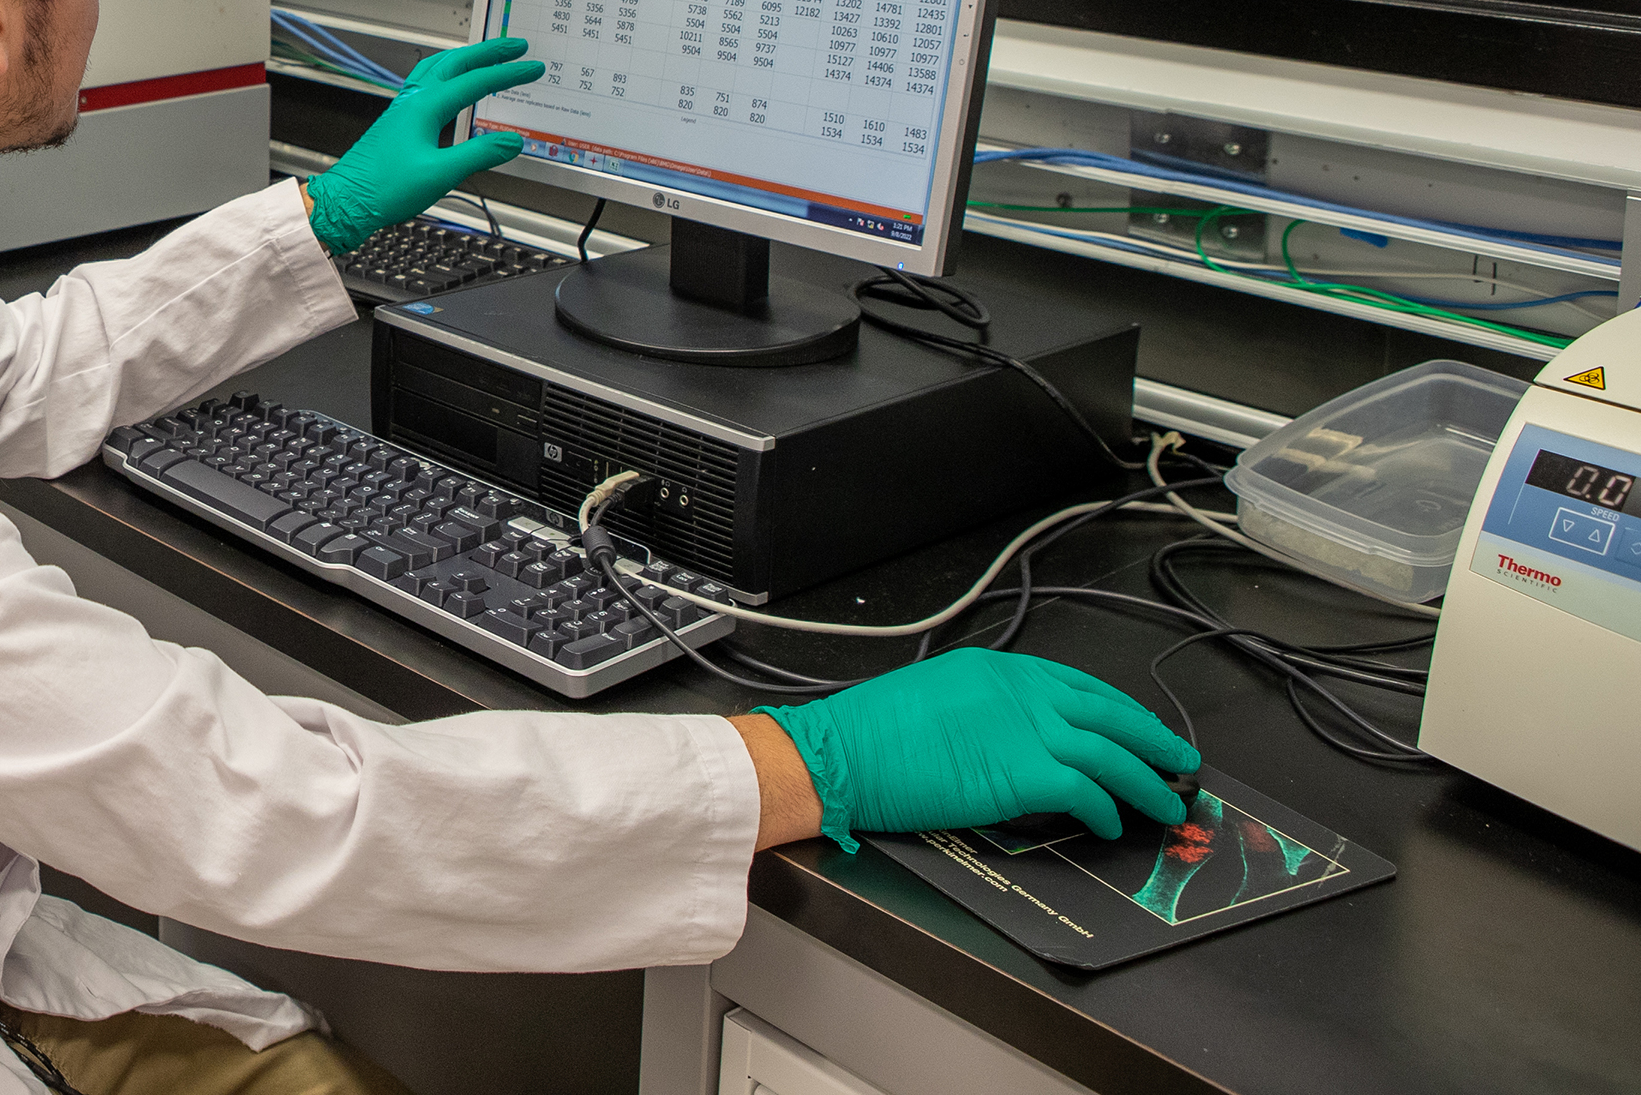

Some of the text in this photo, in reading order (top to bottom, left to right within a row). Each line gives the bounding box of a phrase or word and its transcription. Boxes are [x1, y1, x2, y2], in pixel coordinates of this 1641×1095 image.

[586, 2, 604, 13] 5356
[619, 7, 636, 18] 5356
[686, 18, 705, 29] 5504
[721, 23, 741, 34] 5504
[757, 28, 778, 40] 5504
[829, 40, 856, 52] 10977
[869, 46, 897, 58] 10977
[910, 52, 939, 65] 10977
[688, 4, 707, 16] 5738
[723, 9, 743, 21] 5562
[759, 14, 780, 26] 5213
[831, 26, 858, 38] 10263
[871, 31, 899, 44] 10610
[913, 38, 942, 50] 12057
[761, 1, 782, 12] 6095
[794, 6, 820, 18] 12182
[833, 11, 860, 23] 13427
[873, 17, 901, 30] 13392
[915, 23, 942, 36] 12801
[876, 2, 902, 15] 14781
[917, 8, 945, 20] 12435
[551, 23, 934, 95] 5451 5451 5451 9504 9504 9504 14374 14374 14374
[553, 11, 936, 80] 4830 5644 5878 10211 8565 9737 15127 14406 13588
[548, 74, 924, 154] 752 752 752 820 820 820 1534 1534 1534
[550, 61, 927, 140] 797 567 893 835 751 874 1510 1610 1483
[1566, 466, 1632, 506] 0.0
[1590, 507, 1620, 522] SPEED
[1496, 568, 1558, 594] SCIENTIFIC
[1498, 554, 1562, 588] Thermo
[948, 842, 1011, 886] Technologies
[1011, 884, 1060, 917] Germany
[1057, 914, 1094, 939] GmbH
